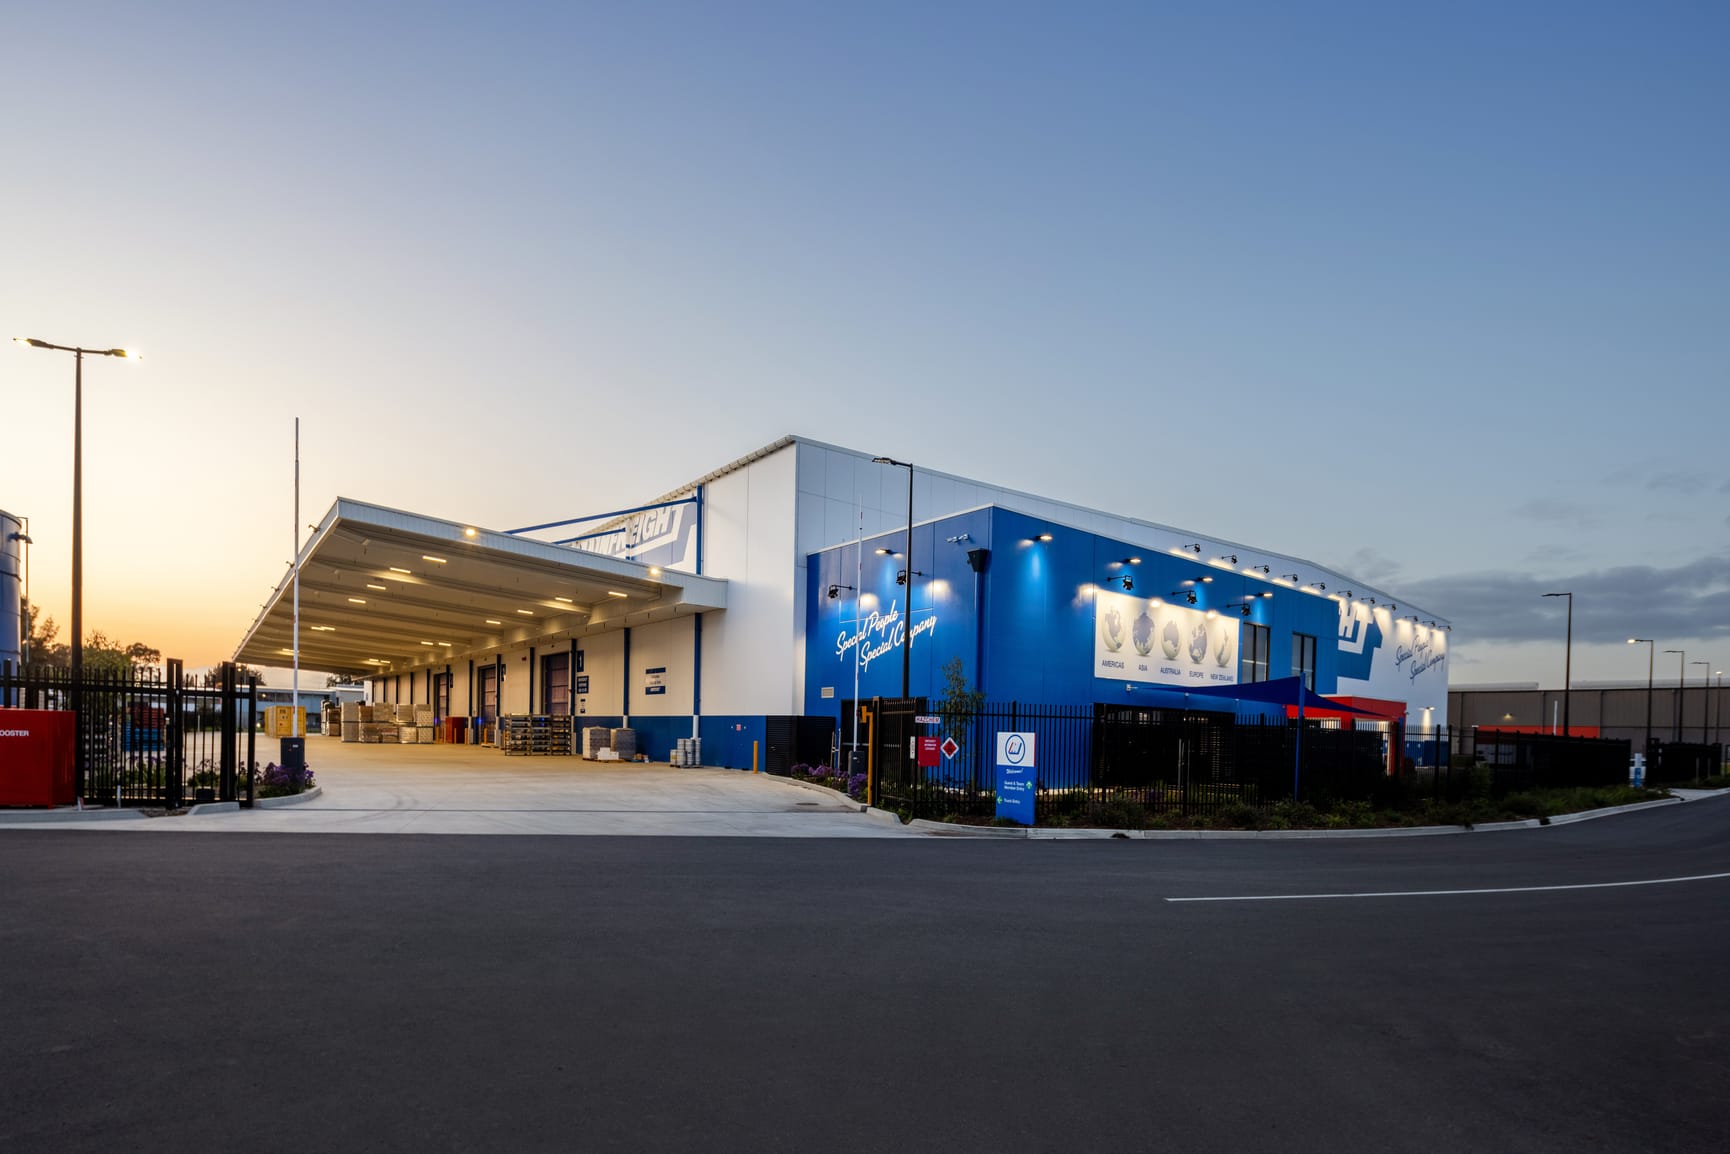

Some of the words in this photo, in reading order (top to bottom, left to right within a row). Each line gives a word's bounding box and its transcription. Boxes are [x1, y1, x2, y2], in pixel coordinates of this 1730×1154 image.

[836, 618, 867, 662] Special
[867, 600, 898, 637] People
[860, 627, 895, 672] Special
[894, 616, 937, 648] Copany
[1101, 659, 1124, 669] AMERICAS
[1138, 664, 1148, 672] ASIA
[1160, 667, 1181, 676] AUSTRALIA
[1189, 670, 1204, 679] EUROPE
[1218, 674, 1234, 682] ZEALAND
